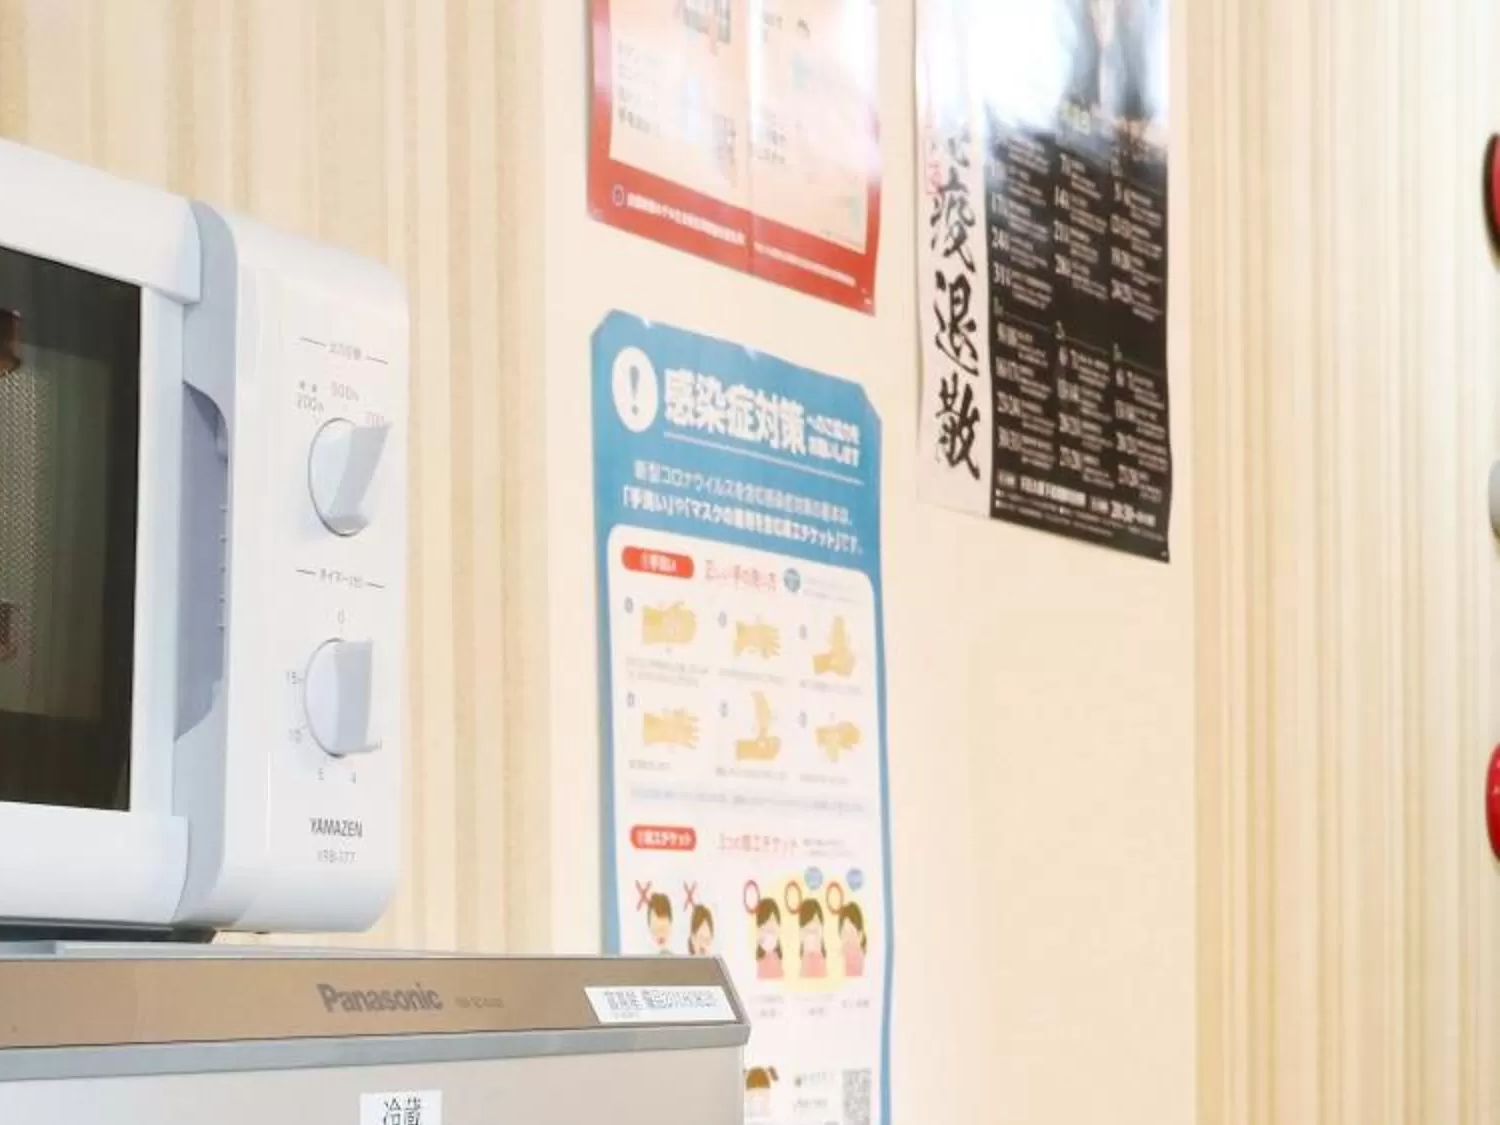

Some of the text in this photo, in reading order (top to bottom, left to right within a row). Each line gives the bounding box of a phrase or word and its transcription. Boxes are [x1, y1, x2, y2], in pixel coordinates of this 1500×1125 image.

[663, 368, 807, 456] 感染症対策
[309, 818, 363, 839] YAMAZEN
[317, 982, 443, 1014] Panasonic
